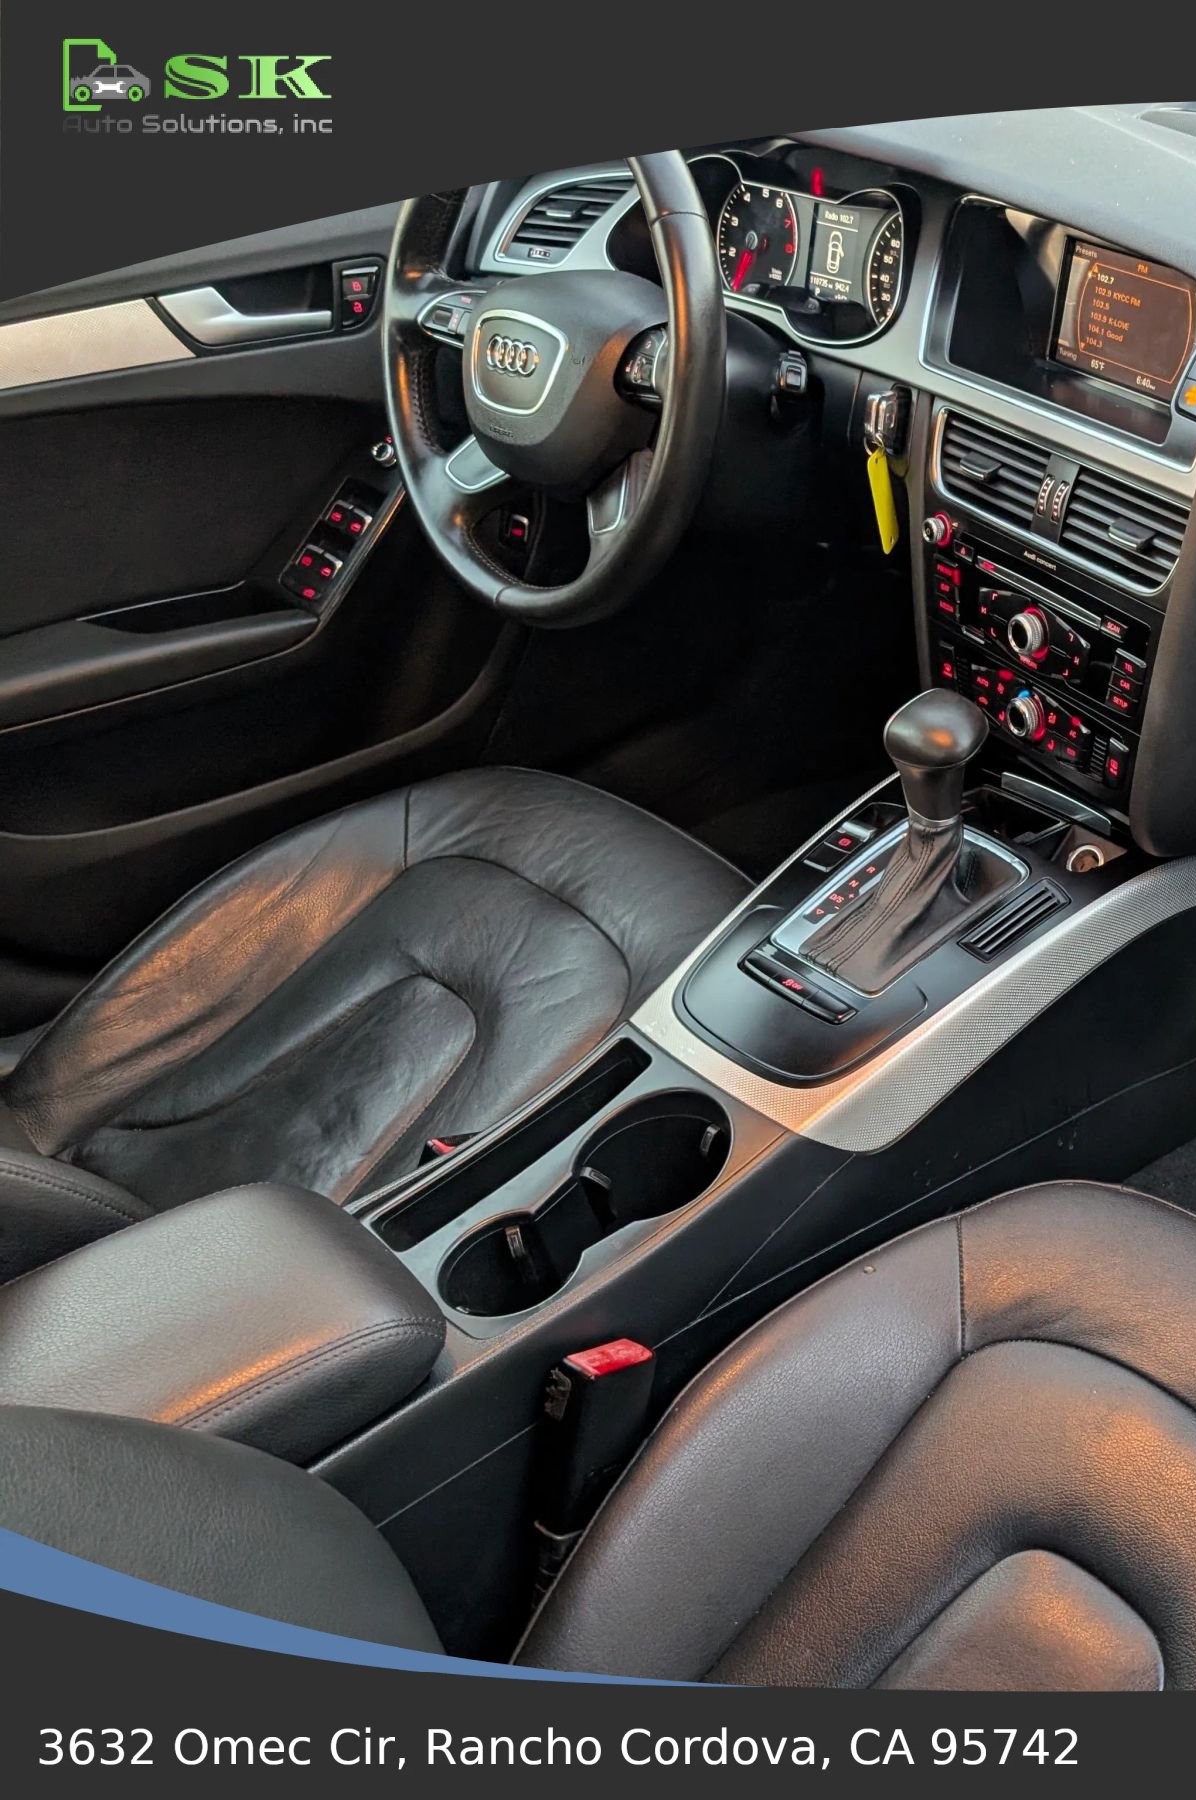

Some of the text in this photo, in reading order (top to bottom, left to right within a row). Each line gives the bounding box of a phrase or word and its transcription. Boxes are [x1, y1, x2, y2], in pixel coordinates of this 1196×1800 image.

[743, 192, 751, 202] 4
[762, 188, 770, 198] 5
[776, 198, 783, 208] 6
[731, 216, 739, 227] 3
[728, 246, 736, 257] 2
[1076, 245, 1098, 258] Presets
[883, 255, 893, 264] 50
[1137, 264, 1148, 274] FM
[880, 274, 890, 283] 40
[1097, 273, 1115, 285] 102.7
[814, 287, 821, 297] P
[881, 292, 891, 302] 30
[1095, 286, 1112, 298] 102.9
[1112, 291, 1130, 303] KYCC
[1060, 346, 1078, 361] Tuning
[1136, 375, 1151, 389] 6:40
[1023, 550, 1057, 571] Audi concert
[1107, 621, 1121, 634] SCAN
[1124, 662, 1133, 673] TEL
[1119, 679, 1130, 690] CAR
[1113, 696, 1128, 709] SETUP
[866, 866, 876, 875] R
[849, 879, 859, 888] N
[829, 893, 845, 904] D/S
